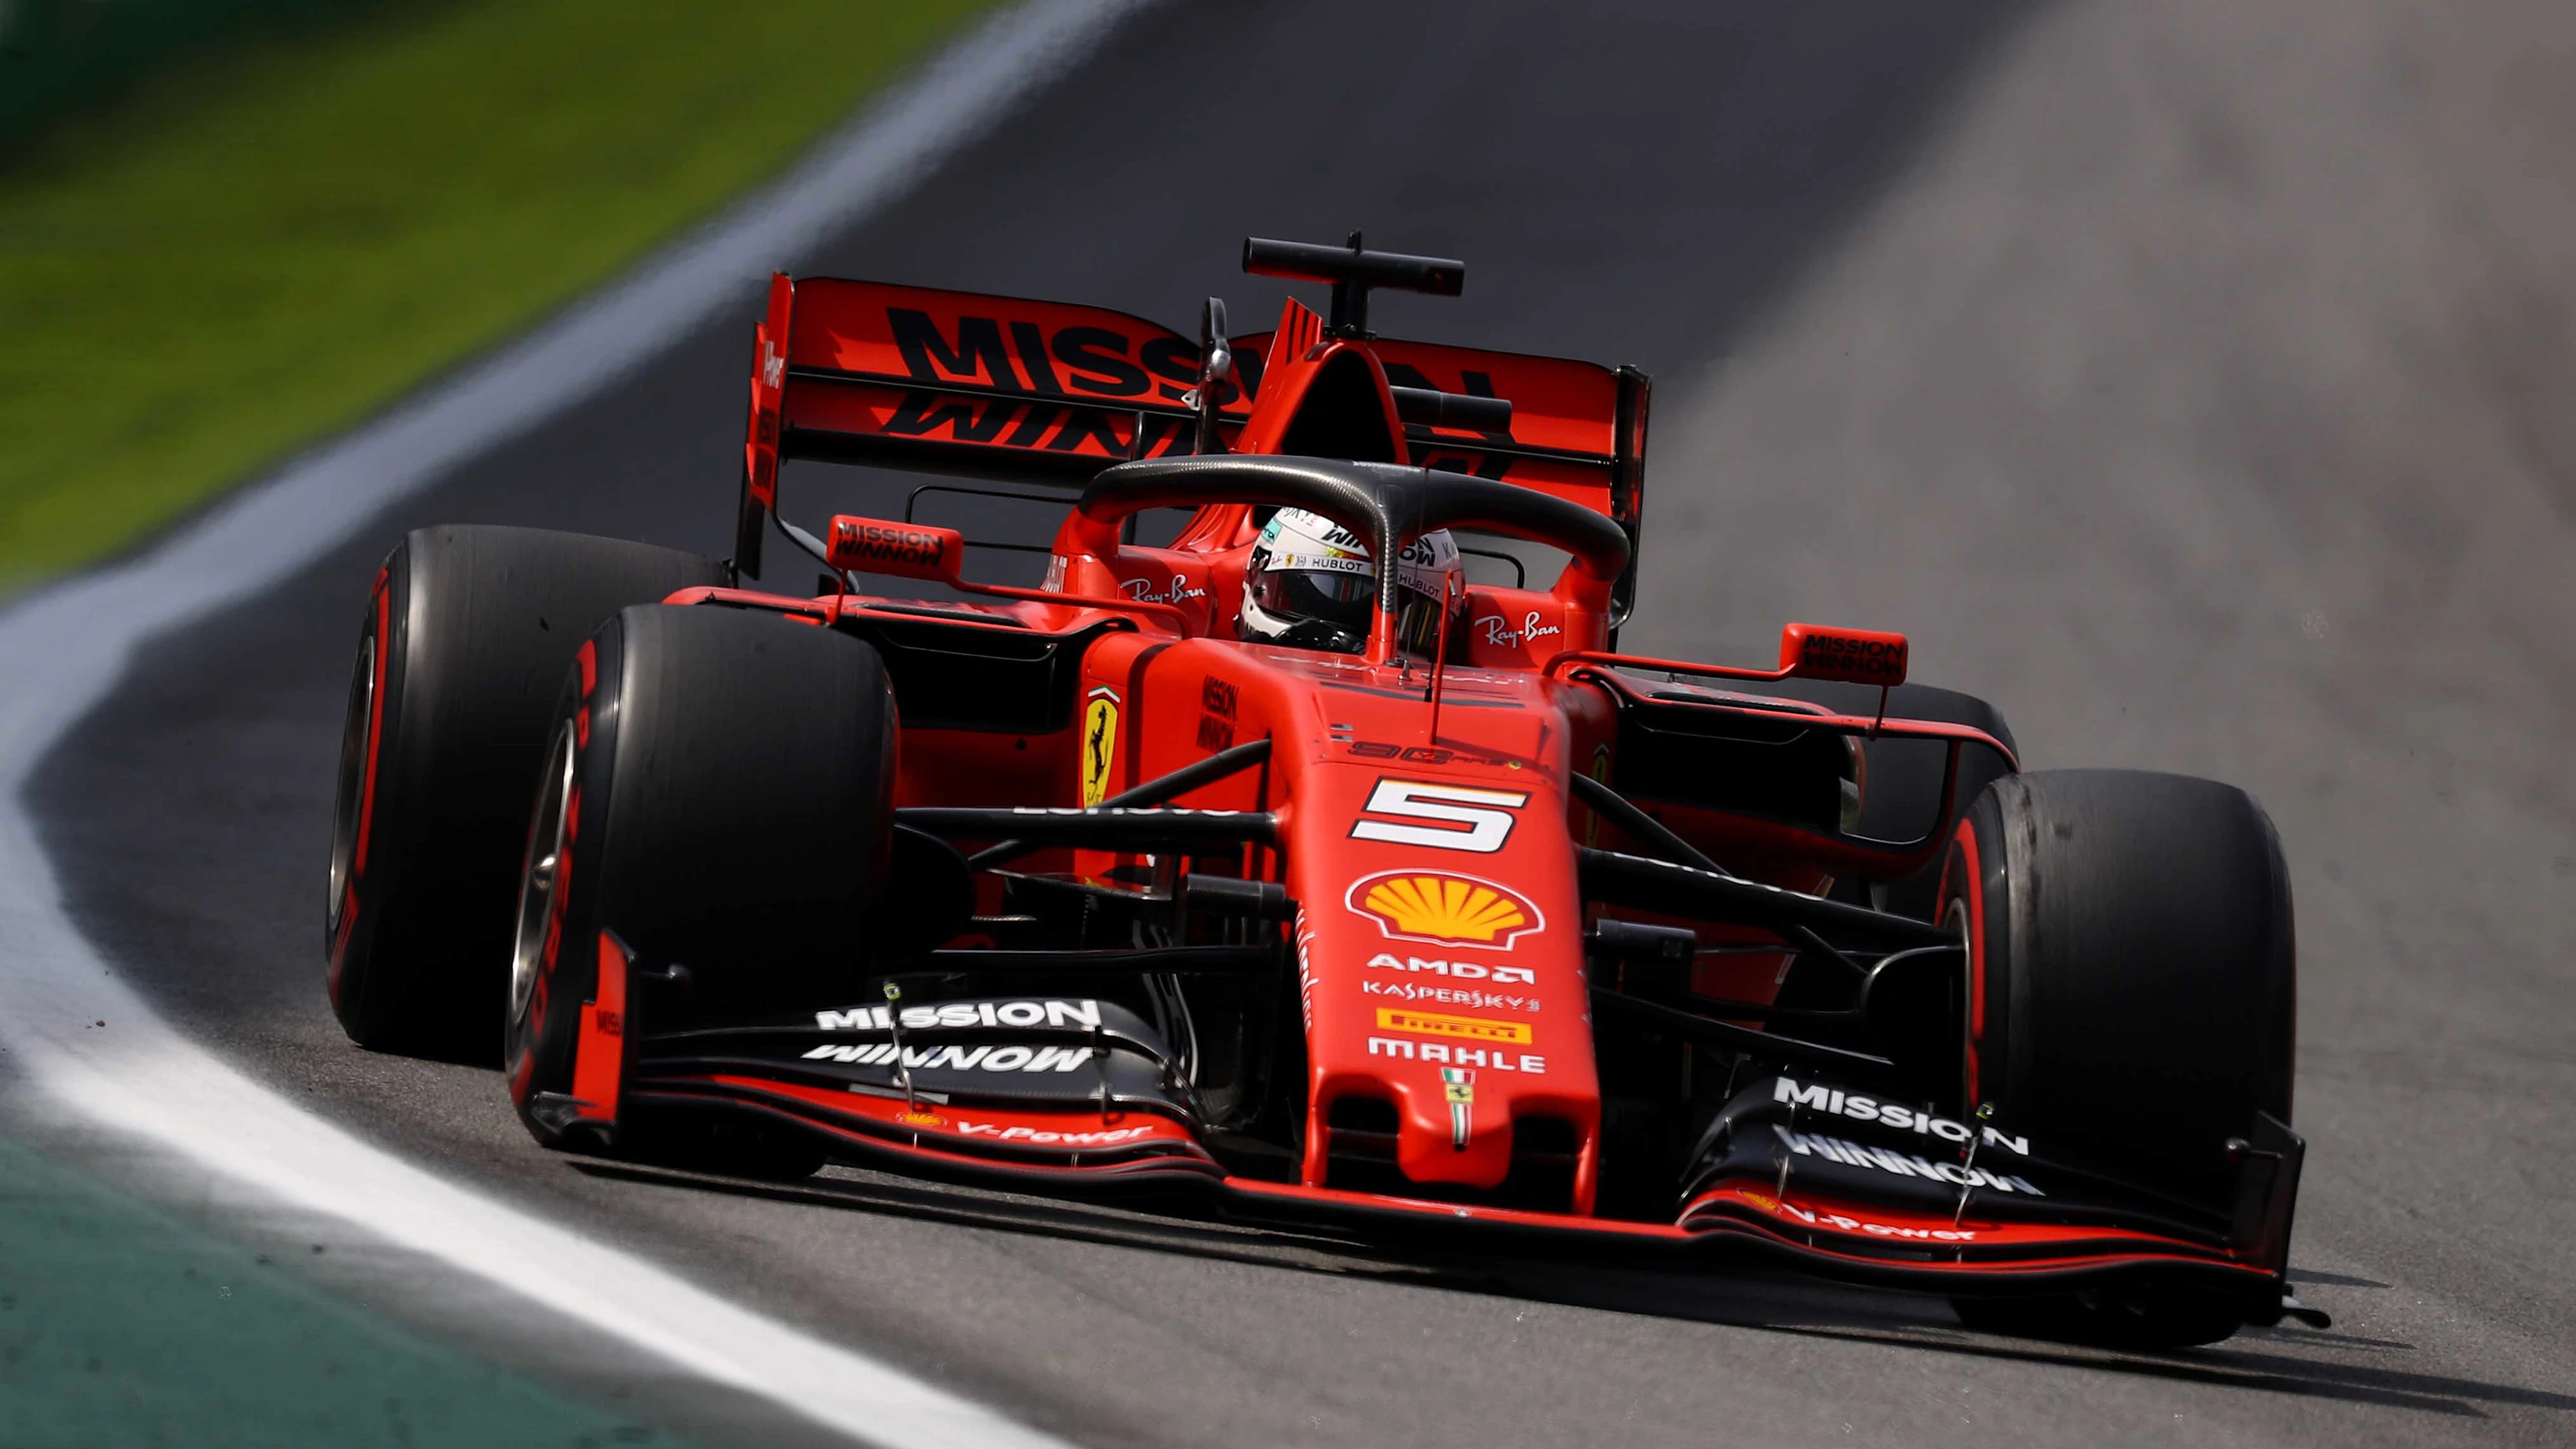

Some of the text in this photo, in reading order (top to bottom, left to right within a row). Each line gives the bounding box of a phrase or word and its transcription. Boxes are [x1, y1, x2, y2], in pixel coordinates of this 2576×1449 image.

[837, 521, 944, 550] MISSION
[835, 538, 942, 567] WINNOW
[1312, 558, 1364, 572] HUBLOT
[1120, 573, 1206, 605] Ray-Ban
[1399, 573, 1441, 597] HUBLOT
[1474, 611, 1561, 649] Ray-Ban
[1804, 634, 1904, 659] MISSION
[1803, 652, 1902, 676] WINNOW
[1347, 775, 1533, 854] 5
[1362, 980, 1525, 1010] KASPERSKY
[815, 999, 1103, 1030] MISSION
[1391, 1013, 1517, 1038] PIRELLI
[801, 1043, 1098, 1072] WINNOW
[1367, 1036, 1546, 1074] MAHLE
[1773, 1075, 2030, 1157] MISSION
[955, 1120, 1154, 1144] V-Power
[1772, 1122, 2047, 1197] WINNOW
